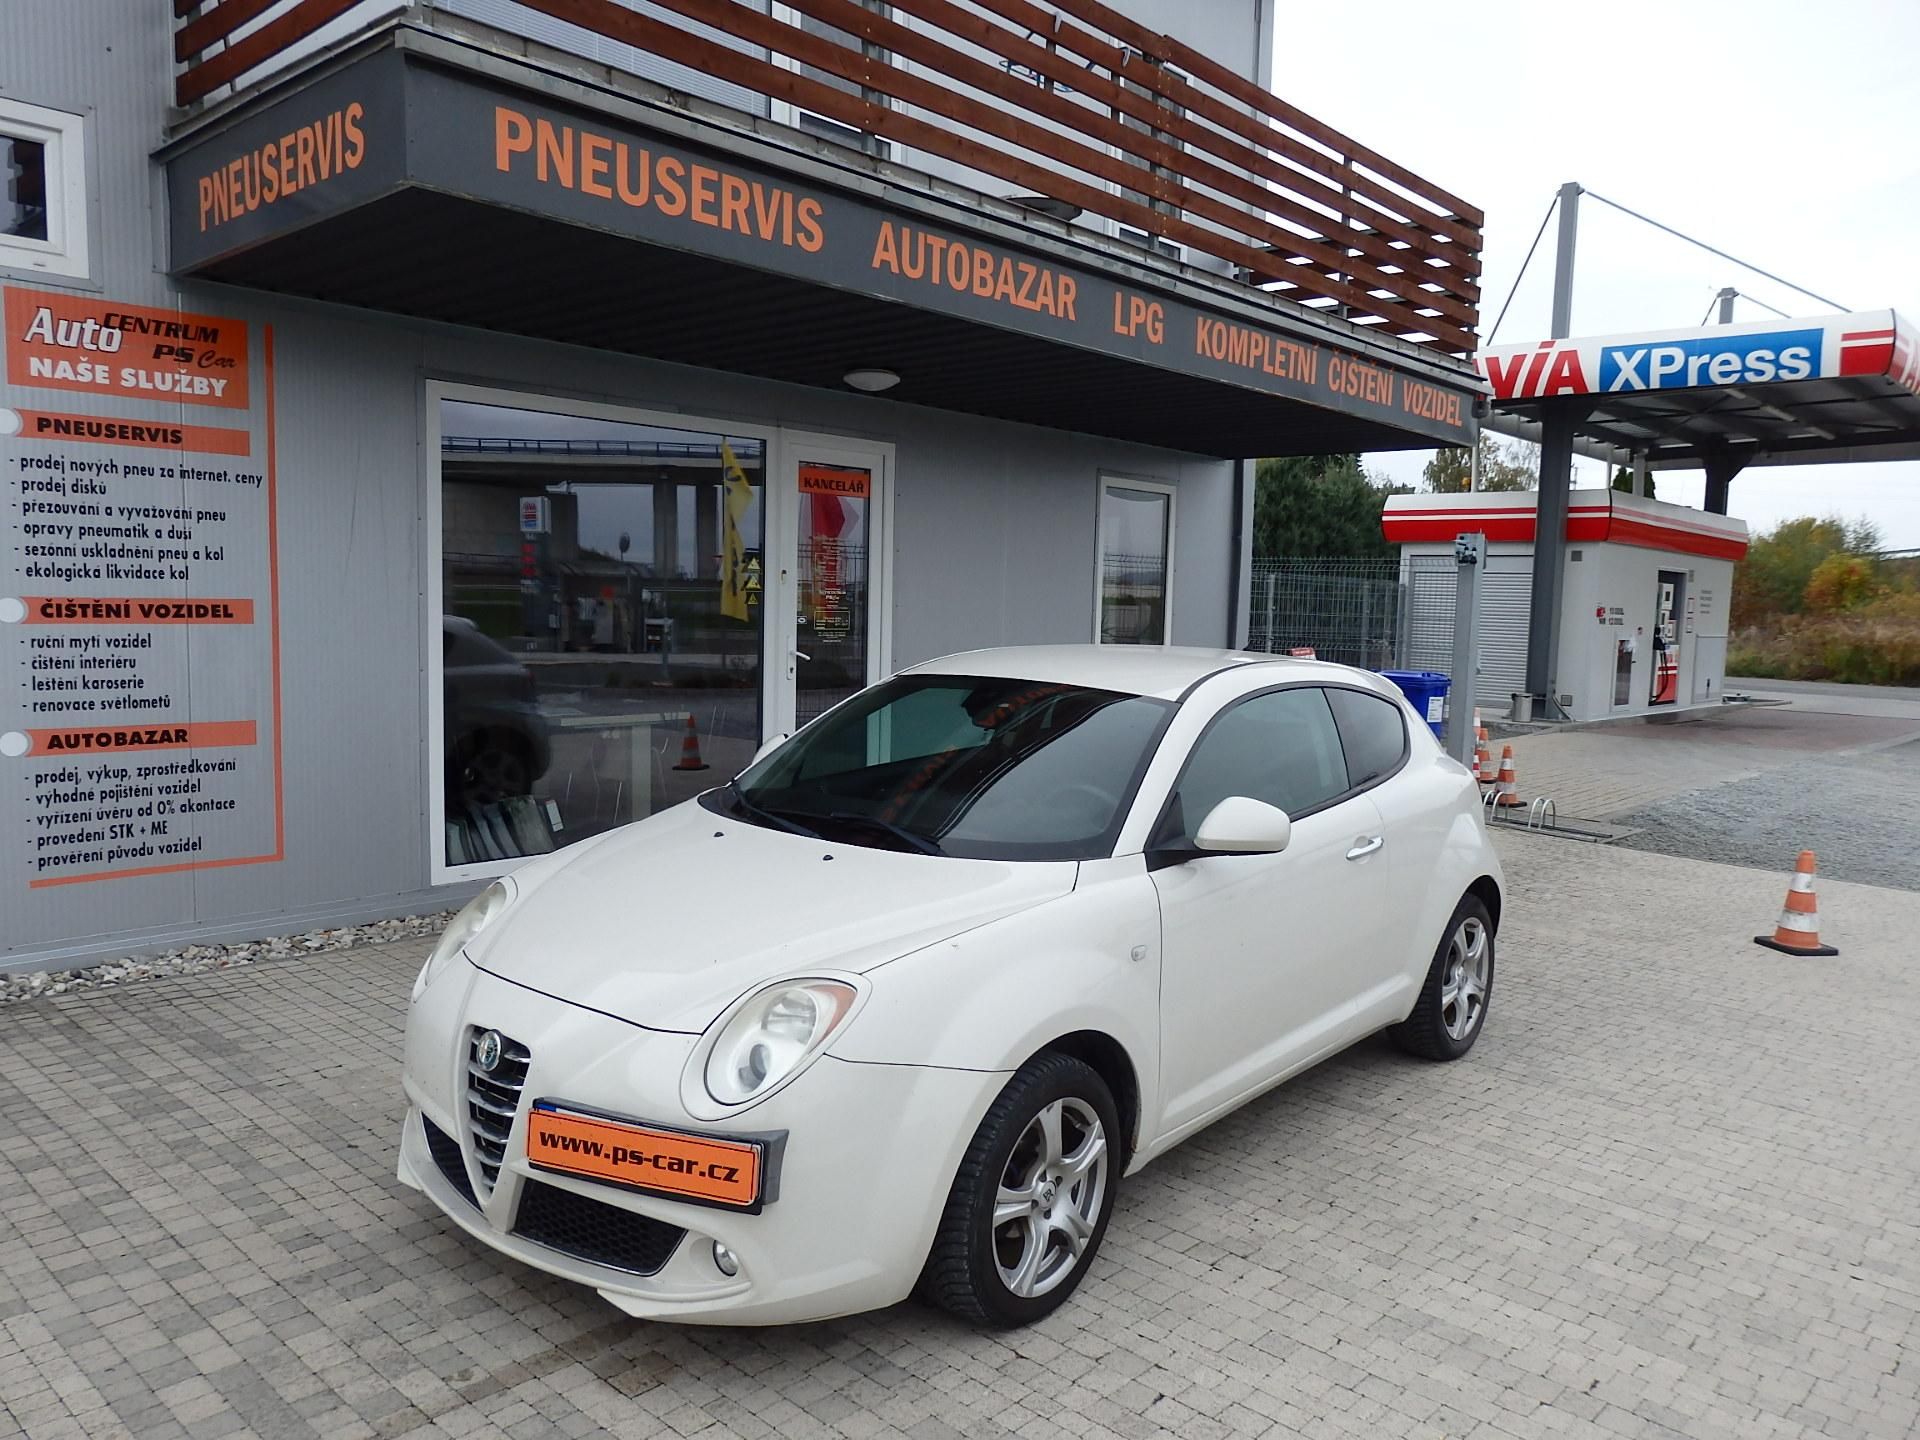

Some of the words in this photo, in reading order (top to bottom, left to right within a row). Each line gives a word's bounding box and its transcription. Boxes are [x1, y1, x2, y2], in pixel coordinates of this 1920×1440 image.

[199, 102, 365, 232] PNEUSERVIS
[495, 106, 824, 252] PNEUSERVIS
[872, 221, 1077, 321] AUTOBAZAR
[1113, 291, 1164, 344] LPG
[1196, 316, 1320, 385] KOMPLETNÍ
[1403, 379, 1462, 427] VOZIDEL
[22, 306, 123, 353] Auto
[103, 312, 219, 344] CENTRUM
[152, 344, 195, 363] PS
[198, 350, 237, 368] Car
[30, 356, 110, 385] NAŠE
[120, 367, 228, 397] SLUŽBY
[1472, 340, 1589, 400] VIA
[1607, 345, 1812, 391] XPress
[37, 416, 183, 444] PNEUSERVIS
[20, 454, 65, 475] prodej
[70, 458, 118, 477] nových
[123, 464, 155, 478] pneu
[160, 467, 174, 478] za
[235, 472, 263, 488] ceny
[21, 476, 66, 497] prodej
[804, 476, 864, 493] KANCELÁŘ
[22, 499, 100, 517] přezouvání
[105, 506, 113, 517] a
[118, 505, 192, 521] vyvažování
[196, 510, 226, 524] pneu
[23, 523, 73, 540] opravy
[79, 523, 149, 540] pneumatik
[154, 528, 163, 539] a
[81, 542, 154, 559] uskladnění
[158, 549, 188, 563] pneu
[193, 550, 200, 560] a
[205, 545, 224, 561] kol
[25, 561, 101, 582] ekologická
[106, 563, 165, 579] likvidace
[169, 564, 189, 581] kol
[40, 598, 131, 619] ČIŠTĚNÍ
[138, 603, 234, 619] VOZIDEL
[31, 634, 65, 649] ruční
[105, 633, 151, 649] vozidel
[31, 654, 75, 670] čištění
[80, 654, 136, 669] interiéru
[32, 675, 78, 691] leštění
[82, 674, 145, 690] karoserie
[33, 700, 96, 713] renovace
[100, 694, 171, 710] světlometů
[47, 729, 188, 750] AUTOBAZAR
[87, 764, 131, 784] výkup,
[136, 758, 236, 780] zprostředkování
[36, 787, 95, 809] výhodné
[100, 783, 153, 804] pojištění
[157, 778, 201, 796] vozidel
[36, 807, 92, 829] vyřízení
[96, 806, 133, 821] úvěru
[137, 801, 153, 817] od
[157, 799, 176, 815] 0%
[179, 798, 236, 814] akontace
[37, 827, 105, 851] provedení
[109, 823, 135, 840] STK
[151, 820, 168, 836] ME
[38, 847, 103, 871] prověření
[107, 841, 154, 864] původu
[158, 836, 202, 854] vozidel
[539, 1131, 740, 1184] www.ps-car.cz
